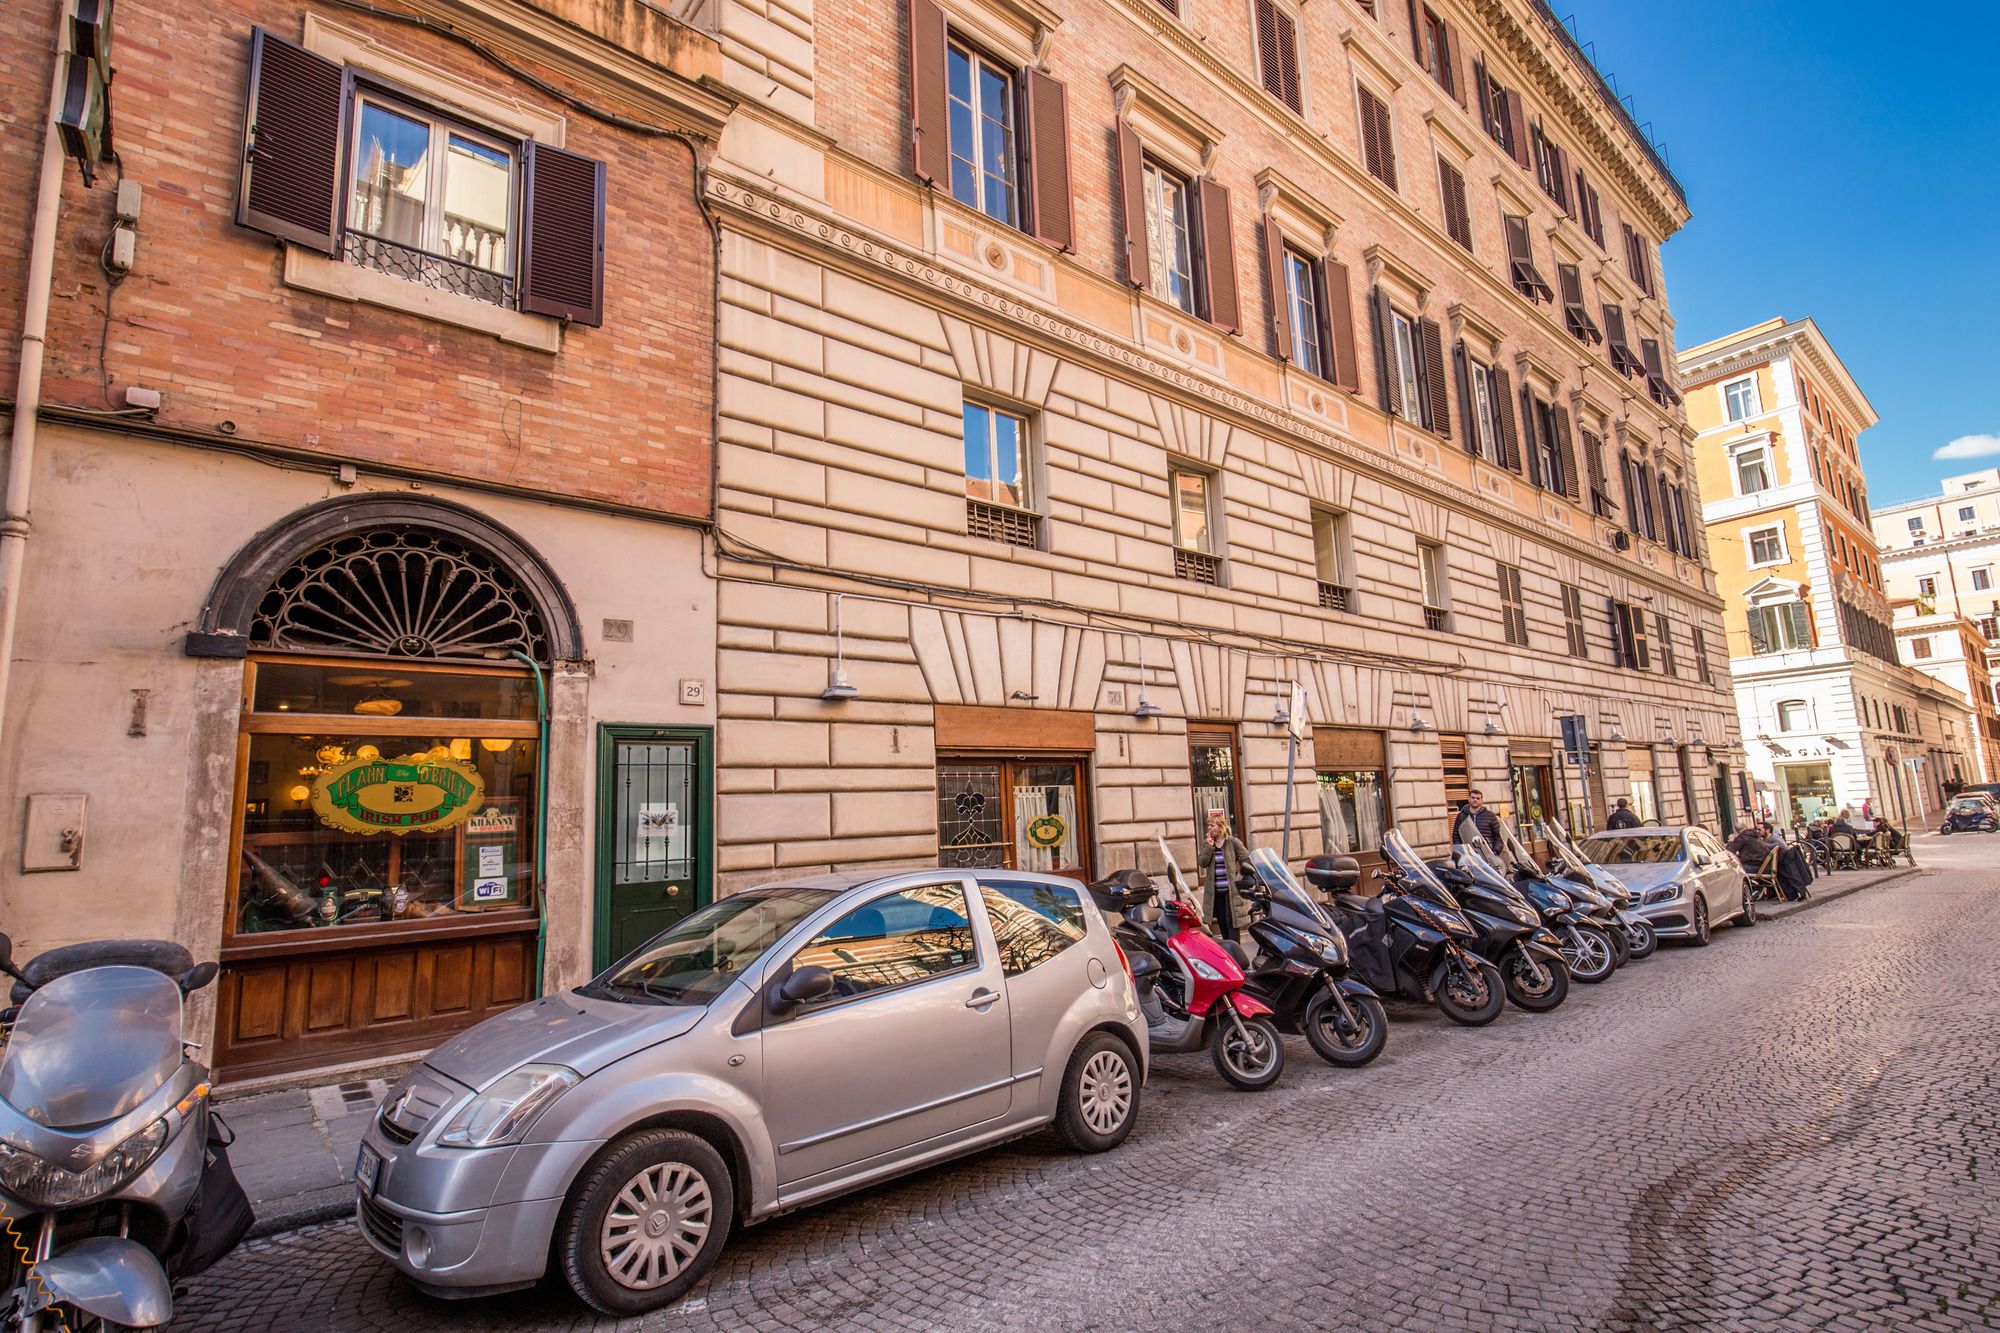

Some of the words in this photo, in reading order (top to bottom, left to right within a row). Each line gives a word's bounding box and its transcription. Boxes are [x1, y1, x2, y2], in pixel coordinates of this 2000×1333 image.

[687, 686, 700, 697] 29
[337, 767, 386, 799] FLANN
[418, 766, 467, 800] O'BRIEN
[359, 809, 401, 825] IRISH
[410, 809, 440, 824] PUB
[470, 817, 513, 827] KILKENNY
